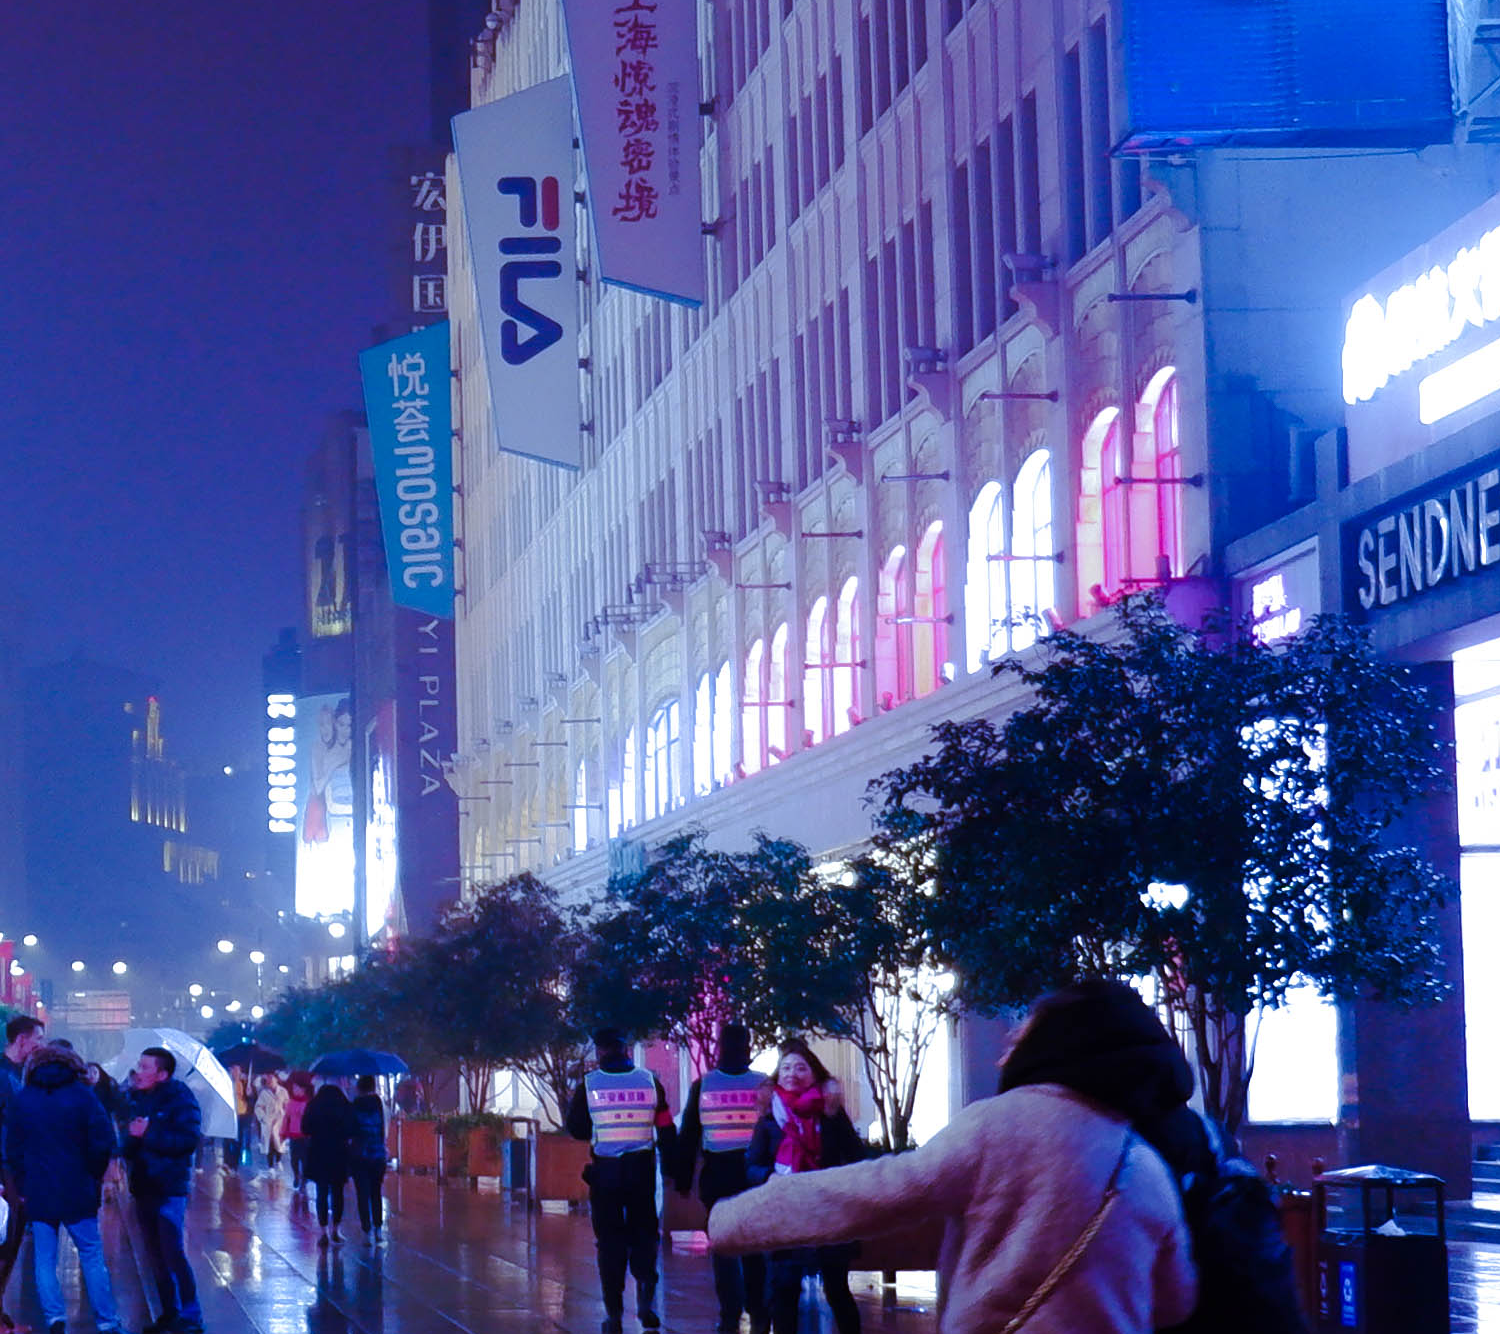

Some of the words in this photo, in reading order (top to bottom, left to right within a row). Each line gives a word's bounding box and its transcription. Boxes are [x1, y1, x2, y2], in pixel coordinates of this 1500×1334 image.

[410, 171, 449, 327] 宏伊国
[496, 176, 563, 366] FILA
[393, 445, 443, 589] mosaic
[267, 726, 298, 833] FOREVER
[416, 674, 442, 798] PLAZA
